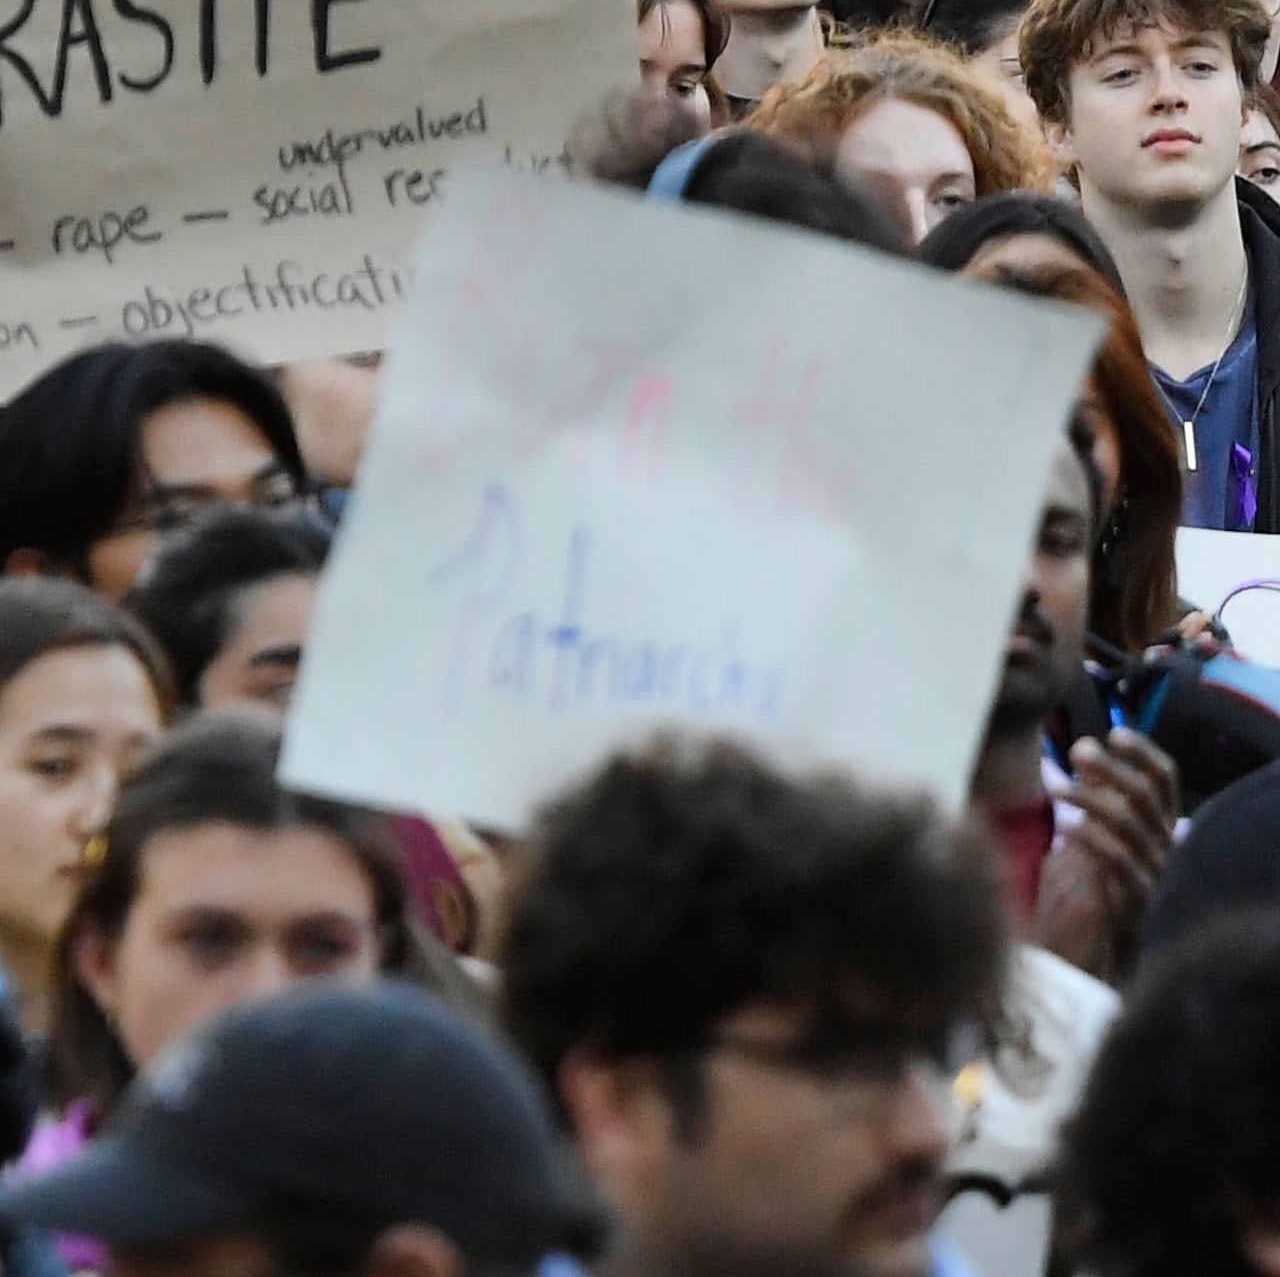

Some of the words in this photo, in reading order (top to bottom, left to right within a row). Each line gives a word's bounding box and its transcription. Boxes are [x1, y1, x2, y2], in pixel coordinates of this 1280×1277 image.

[278, 97, 487, 171] undervalued
[50, 204, 163, 265] rape
[253, 165, 354, 224] social
[121, 255, 406, 338] objectificati
